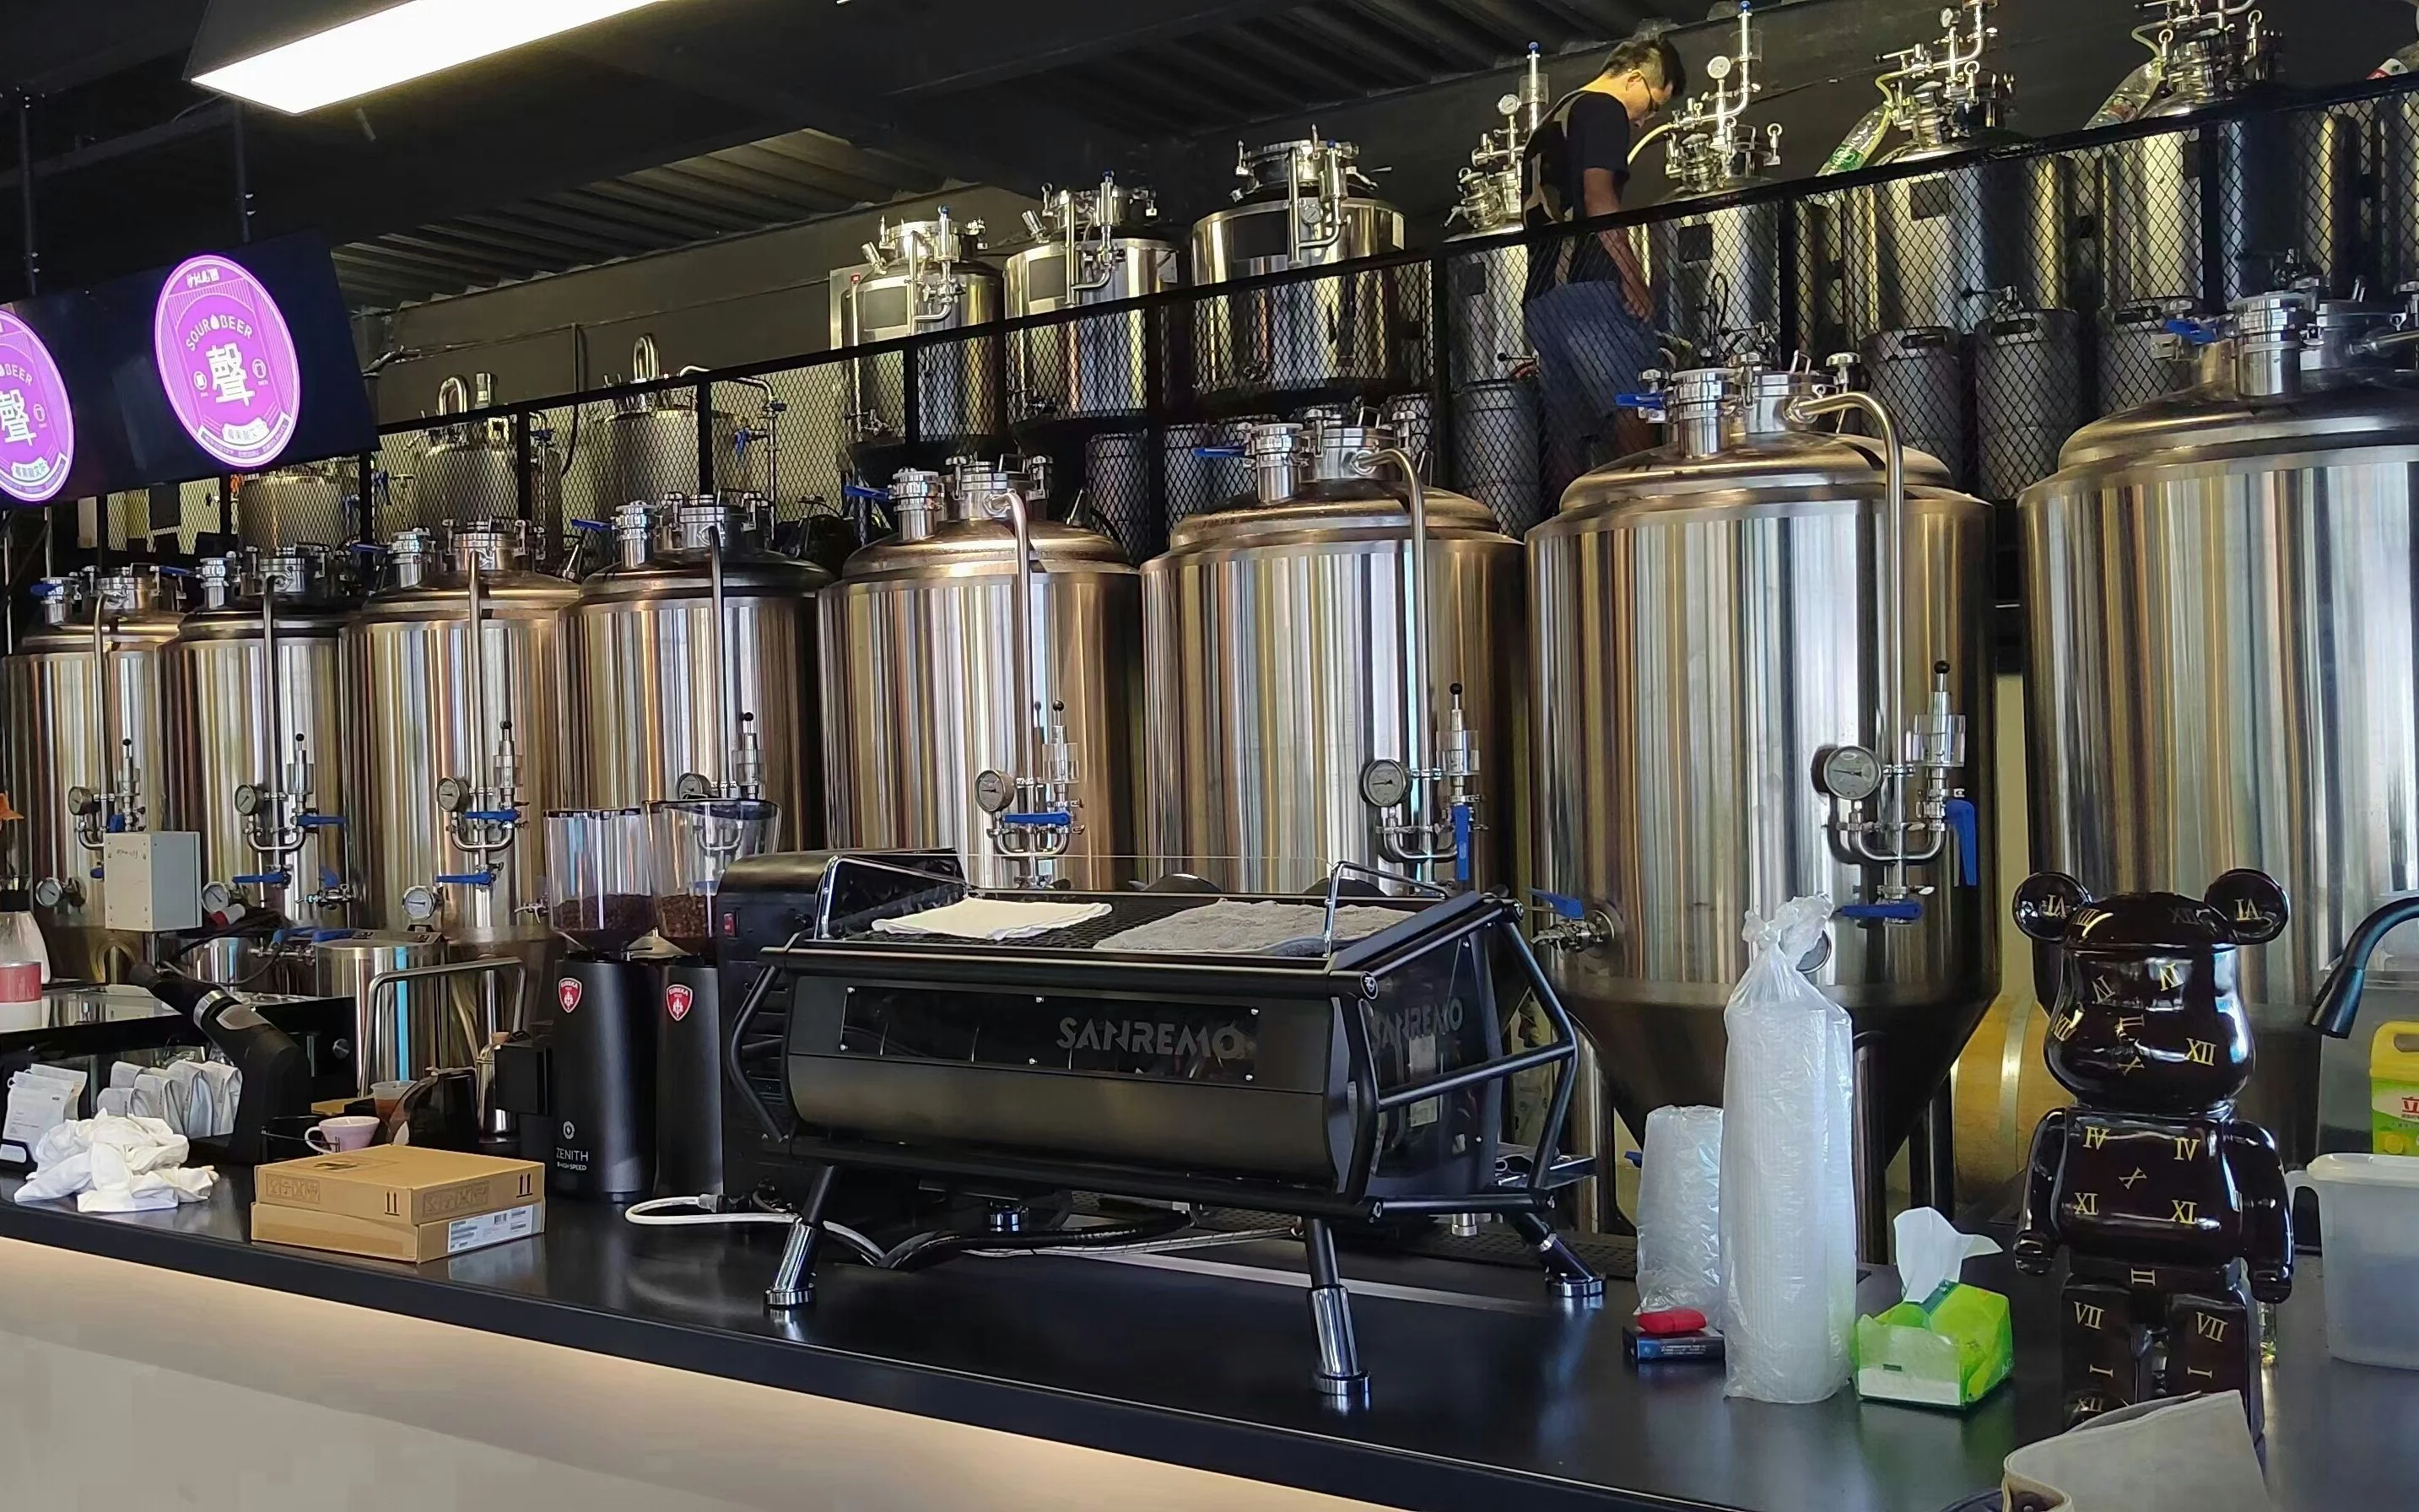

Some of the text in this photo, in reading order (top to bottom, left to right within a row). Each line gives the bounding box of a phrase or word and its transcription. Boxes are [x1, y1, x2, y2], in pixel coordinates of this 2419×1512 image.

[186, 315, 253, 351] SOUR BEER
[1056, 1017, 1245, 1060] SANREMO
[1369, 997, 1463, 1056] SANREMO
[2185, 1038, 2217, 1066] XII
[2083, 1126, 2111, 1150] IV
[2174, 1137, 2200, 1161] IV
[556, 1147, 589, 1162] ZENITH
[2073, 1192, 2099, 1216] XI
[2169, 1200, 2198, 1224] XI
[2074, 1301, 2105, 1330] VII
[2196, 1311, 2228, 1342] VII
